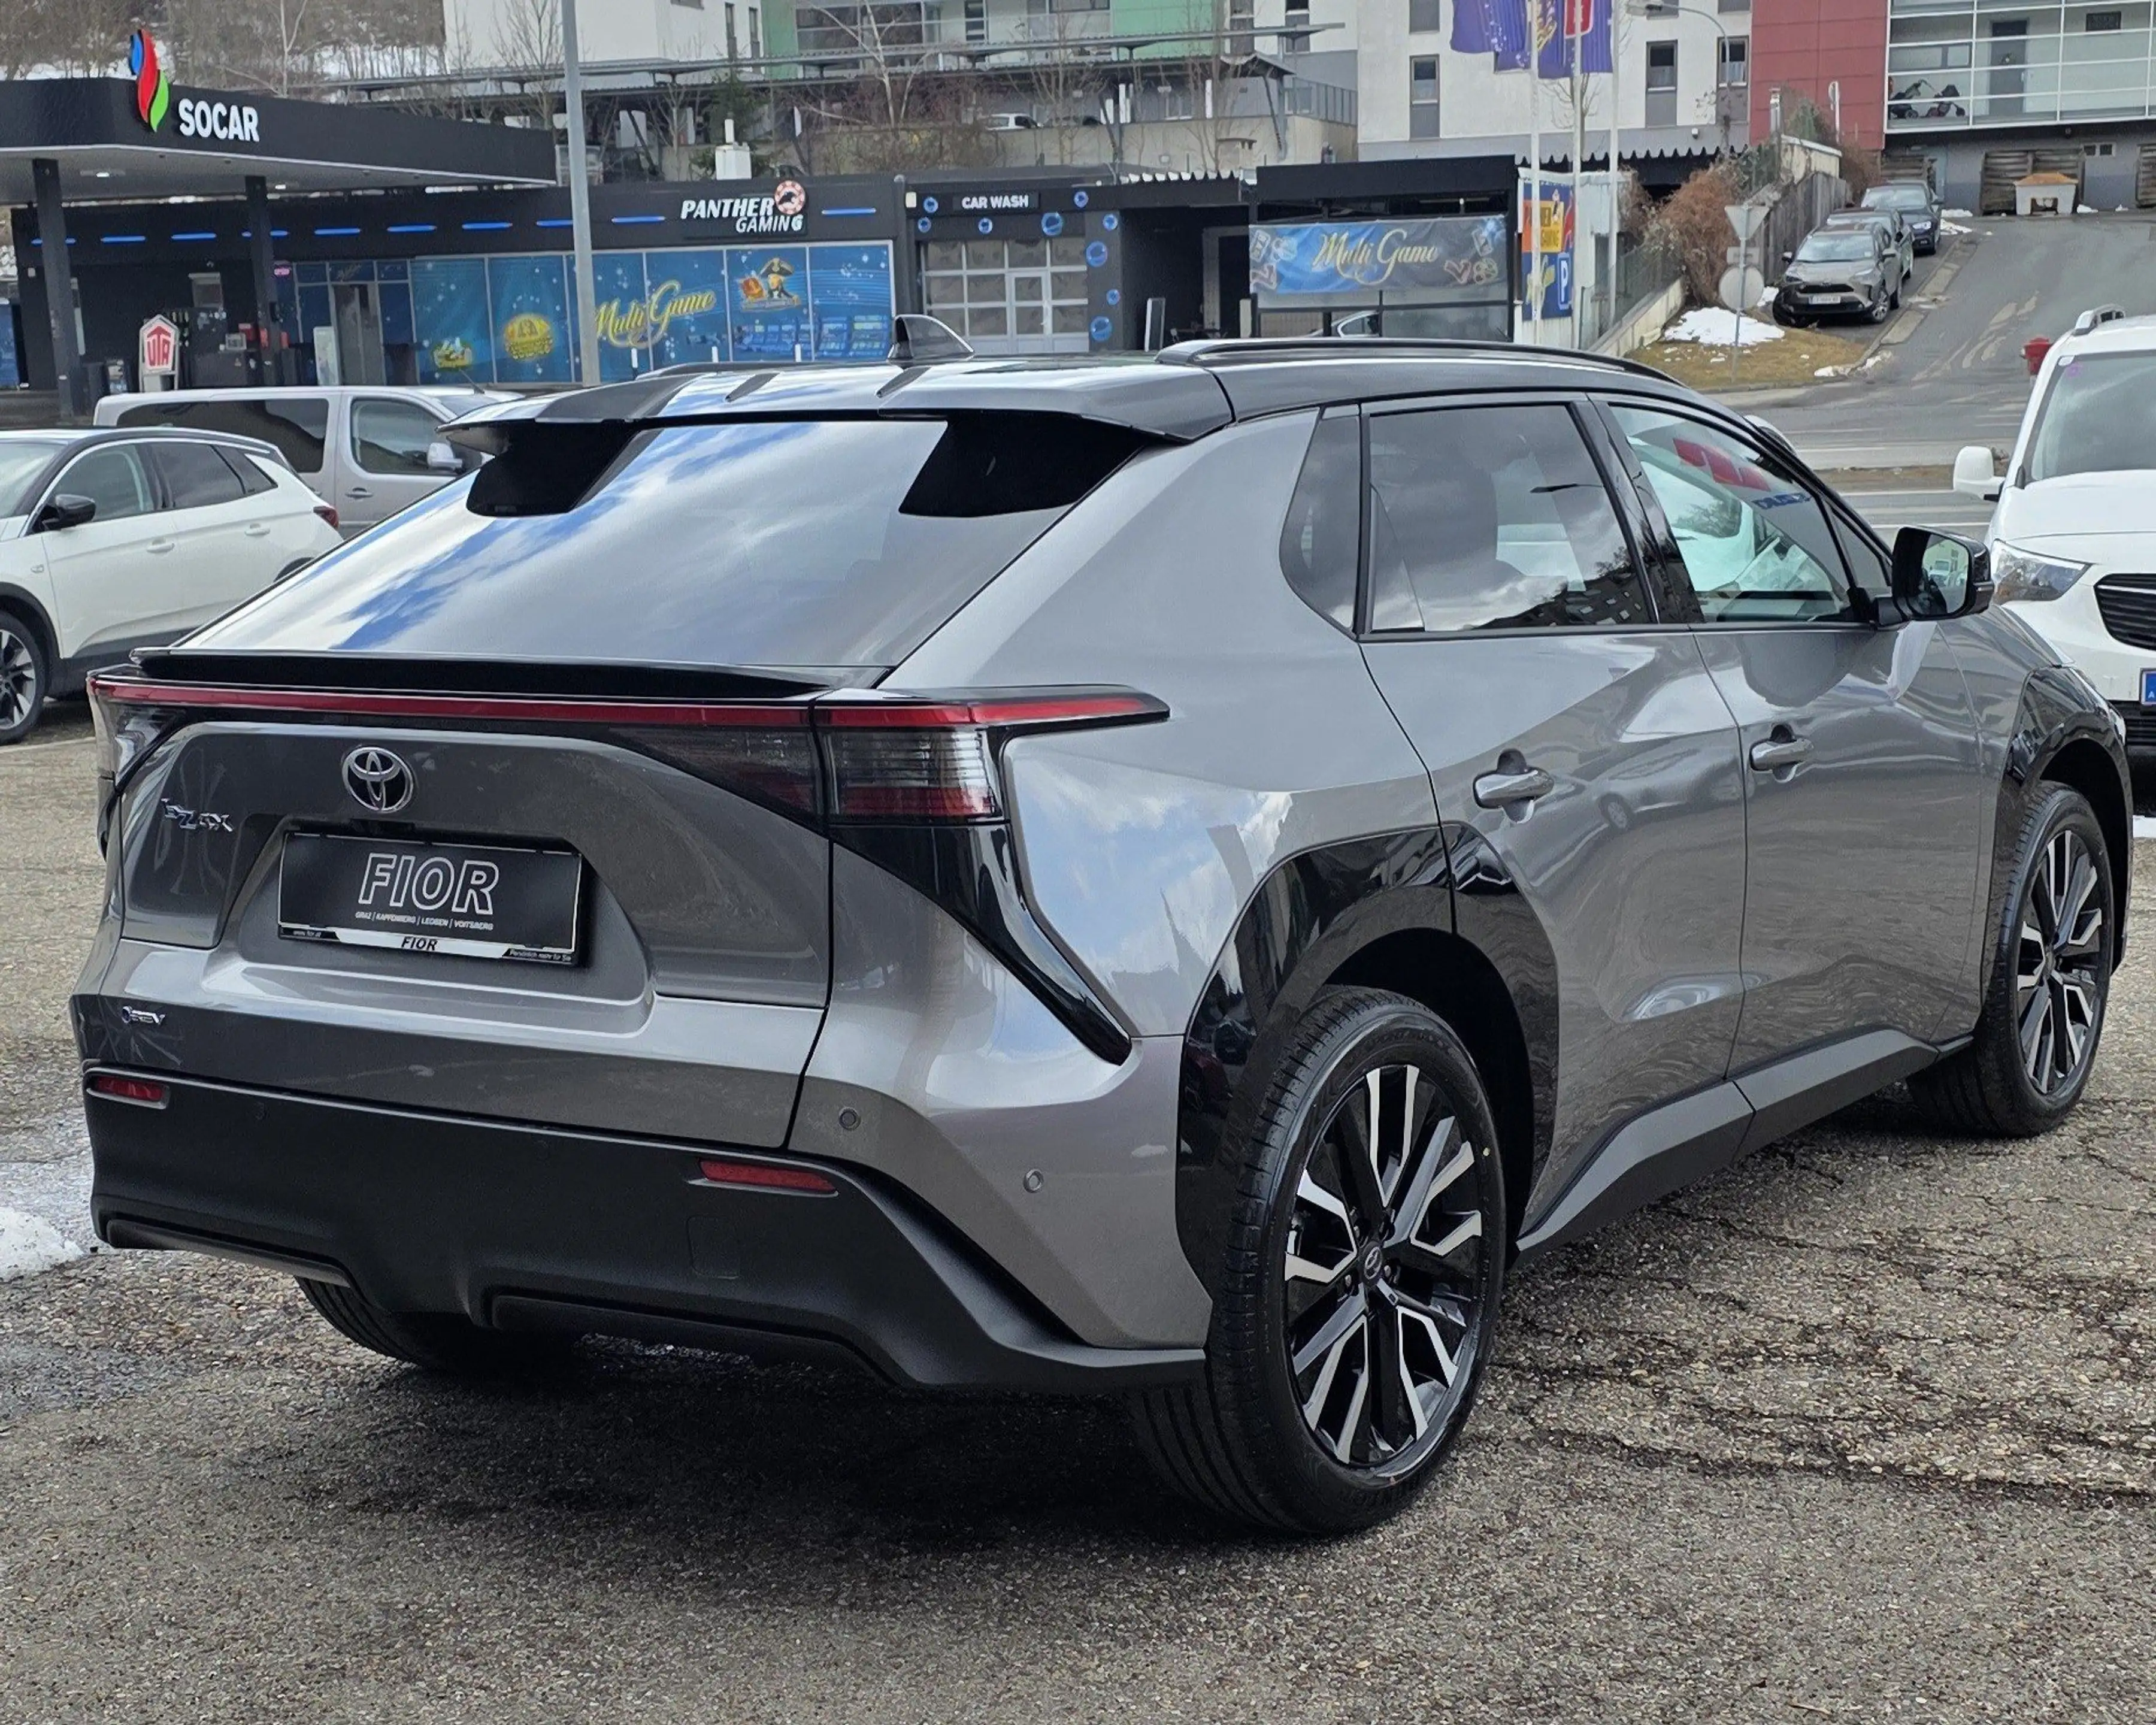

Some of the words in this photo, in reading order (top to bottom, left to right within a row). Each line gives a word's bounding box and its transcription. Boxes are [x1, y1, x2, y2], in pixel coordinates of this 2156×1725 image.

[178, 98, 260, 142] SOCAR
[680, 197, 775, 219] PANTHER
[961, 196, 988, 209] CAR
[989, 195, 1029, 208] WASH
[735, 214, 804, 233] GAMING
[1377, 228, 1439, 286] Game
[649, 279, 715, 346] Game
[147, 326, 171, 367] UTA
[2148, 690, 2155, 699] A
[358, 853, 499, 915] FIOR
[401, 936, 438, 951] FIOR
